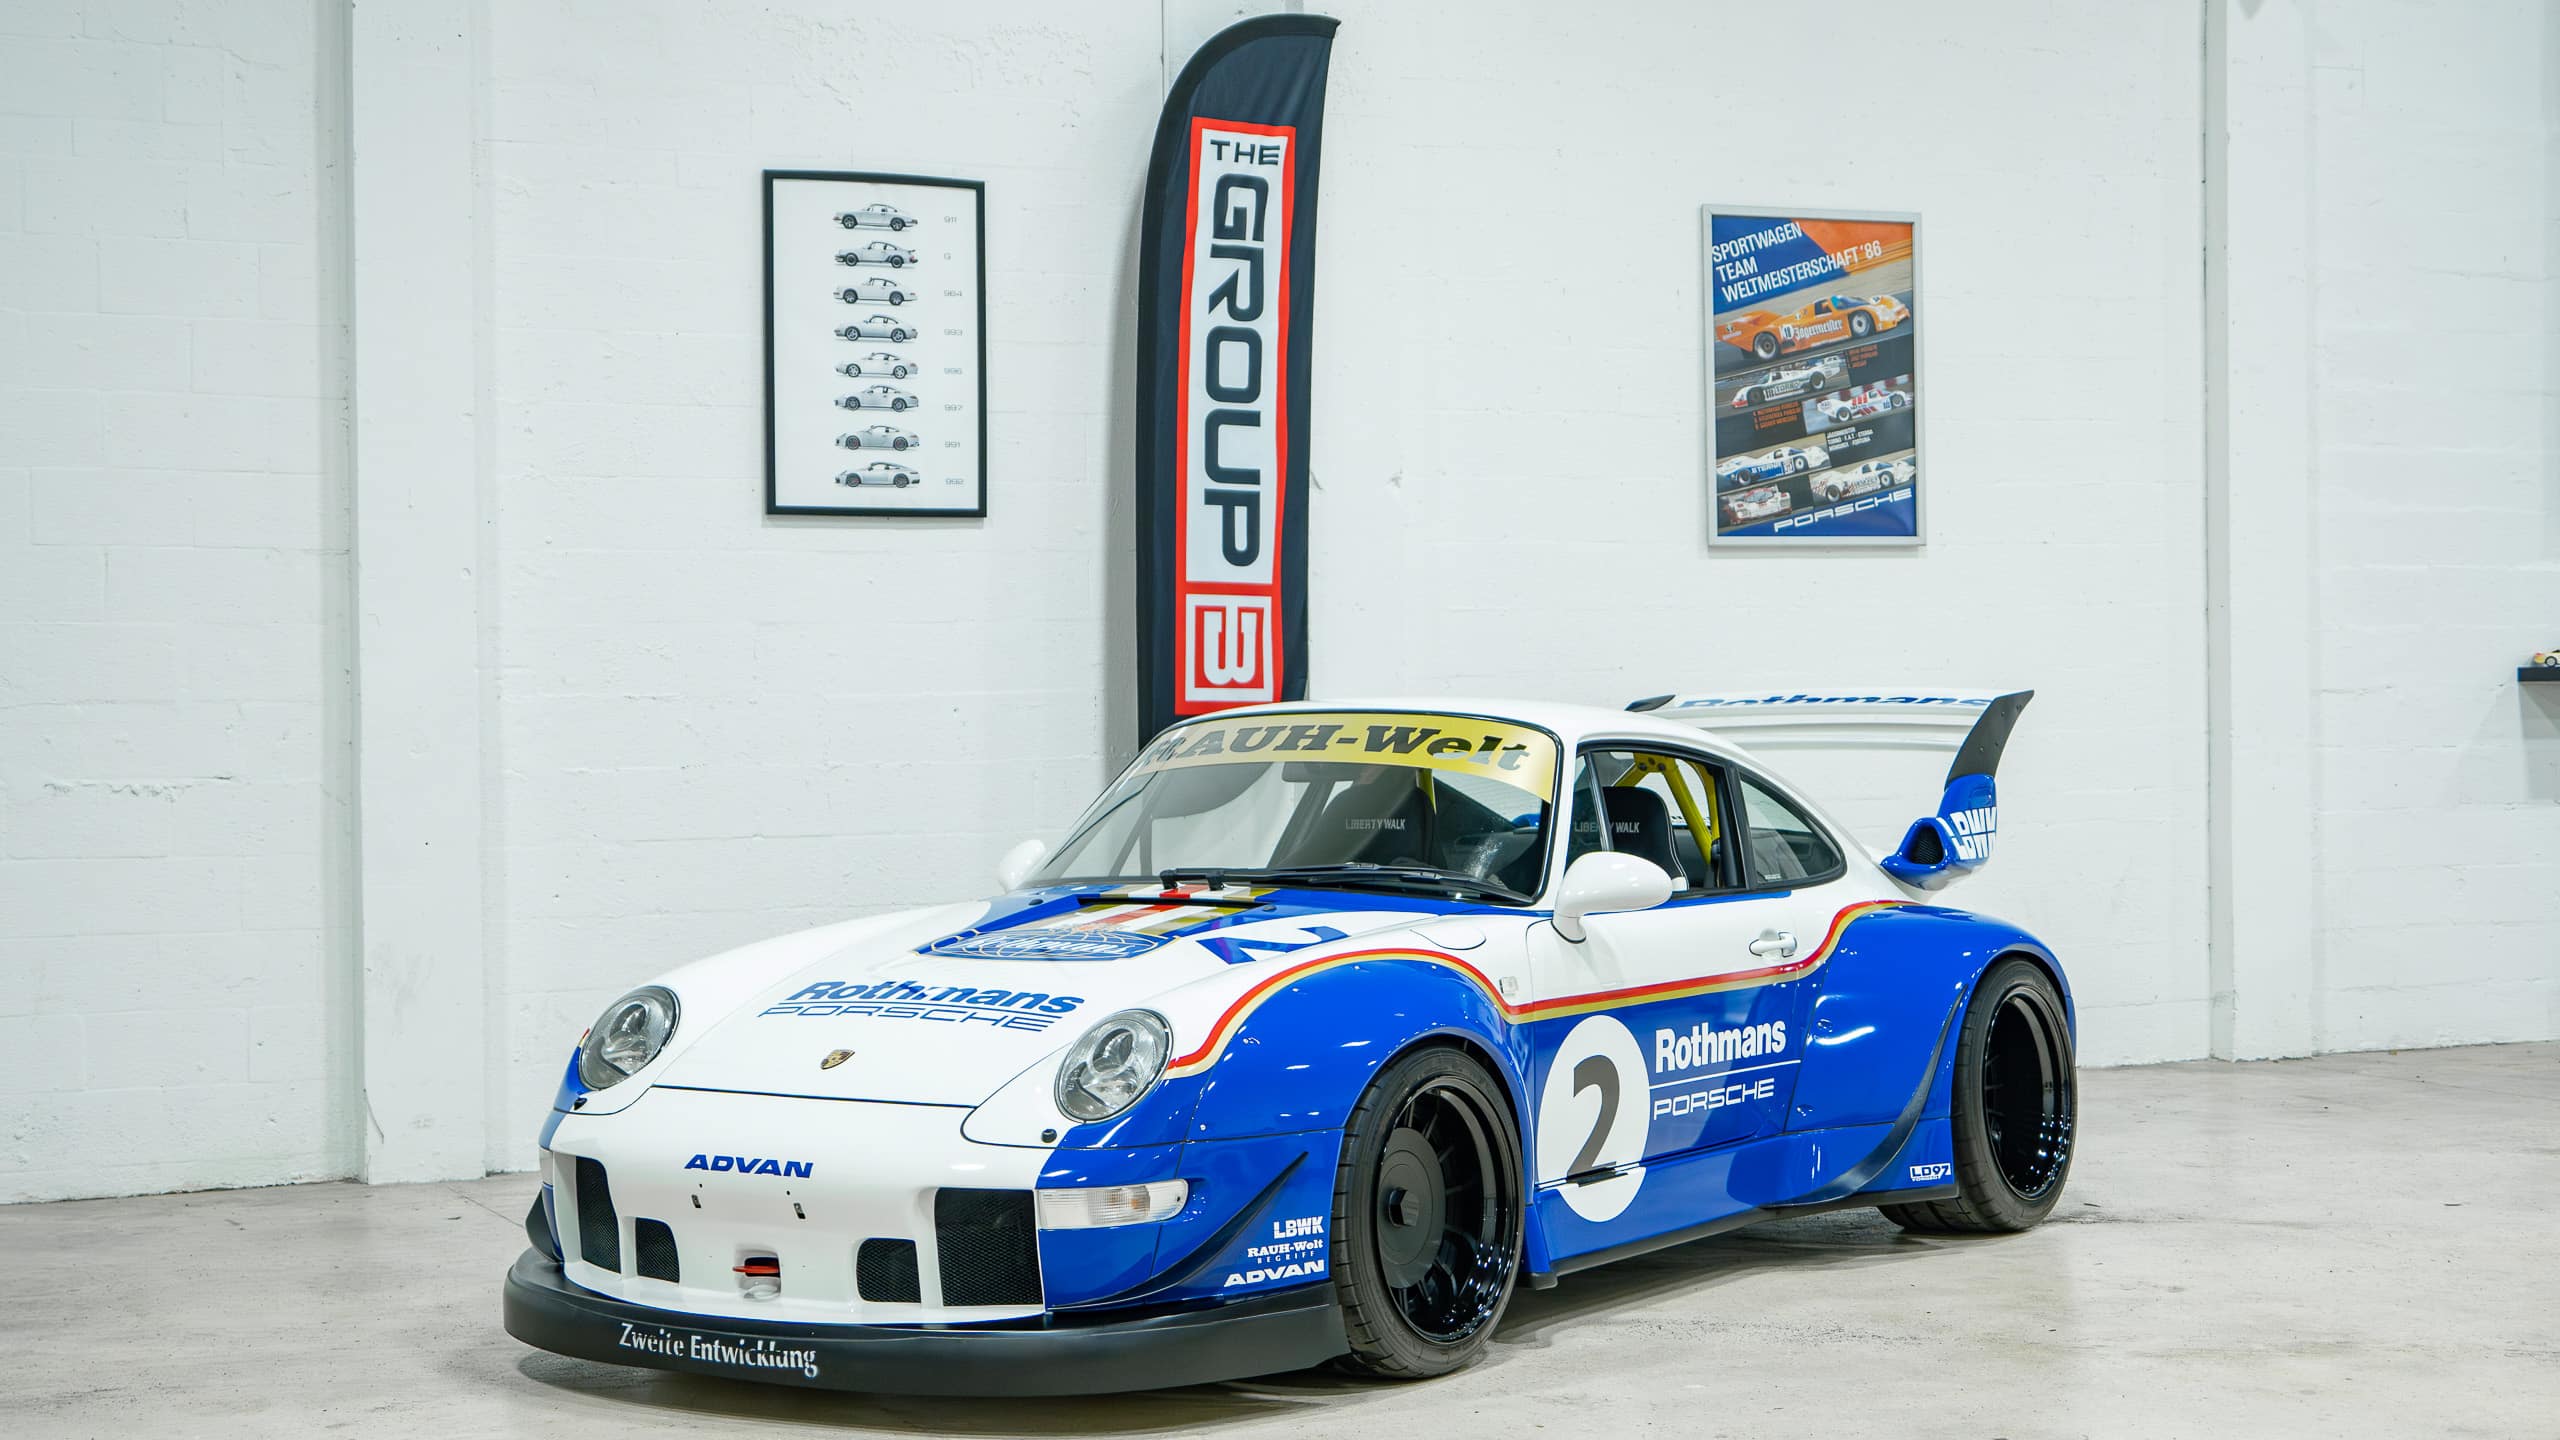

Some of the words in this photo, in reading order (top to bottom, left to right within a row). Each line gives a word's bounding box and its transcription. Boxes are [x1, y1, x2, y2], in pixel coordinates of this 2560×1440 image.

[1210, 139, 1281, 166] THE
[1712, 221, 1803, 263] SPORTWAGEN
[1716, 256, 1758, 282] TEAM
[1722, 246, 1858, 302] WELTMEISTERSCHAFT
[1204, 173, 1269, 567] GROUP
[1774, 487, 1913, 533] PORSCHE
[1146, 724, 1530, 771] RAUH-Welt
[1384, 818, 1406, 830] WALK
[1615, 821, 1640, 833] WALK
[786, 981, 1085, 1013] Rothmans
[757, 1005, 1055, 1032] PORSCHE
[1656, 1020, 1786, 1073] Rothmans
[1653, 1077, 1774, 1120] PORSCHE
[1567, 1054, 1629, 1188] 2
[684, 1154, 814, 1178] ADVAN
[1911, 1164, 1949, 1177] LD97
[1273, 1216, 1325, 1239] LBWK
[1247, 1239, 1324, 1258] RAUH-Welt
[1223, 1259, 1325, 1288] ADVAN
[617, 1322, 685, 1357] Zweite
[690, 1335, 819, 1378] Entwicklung
